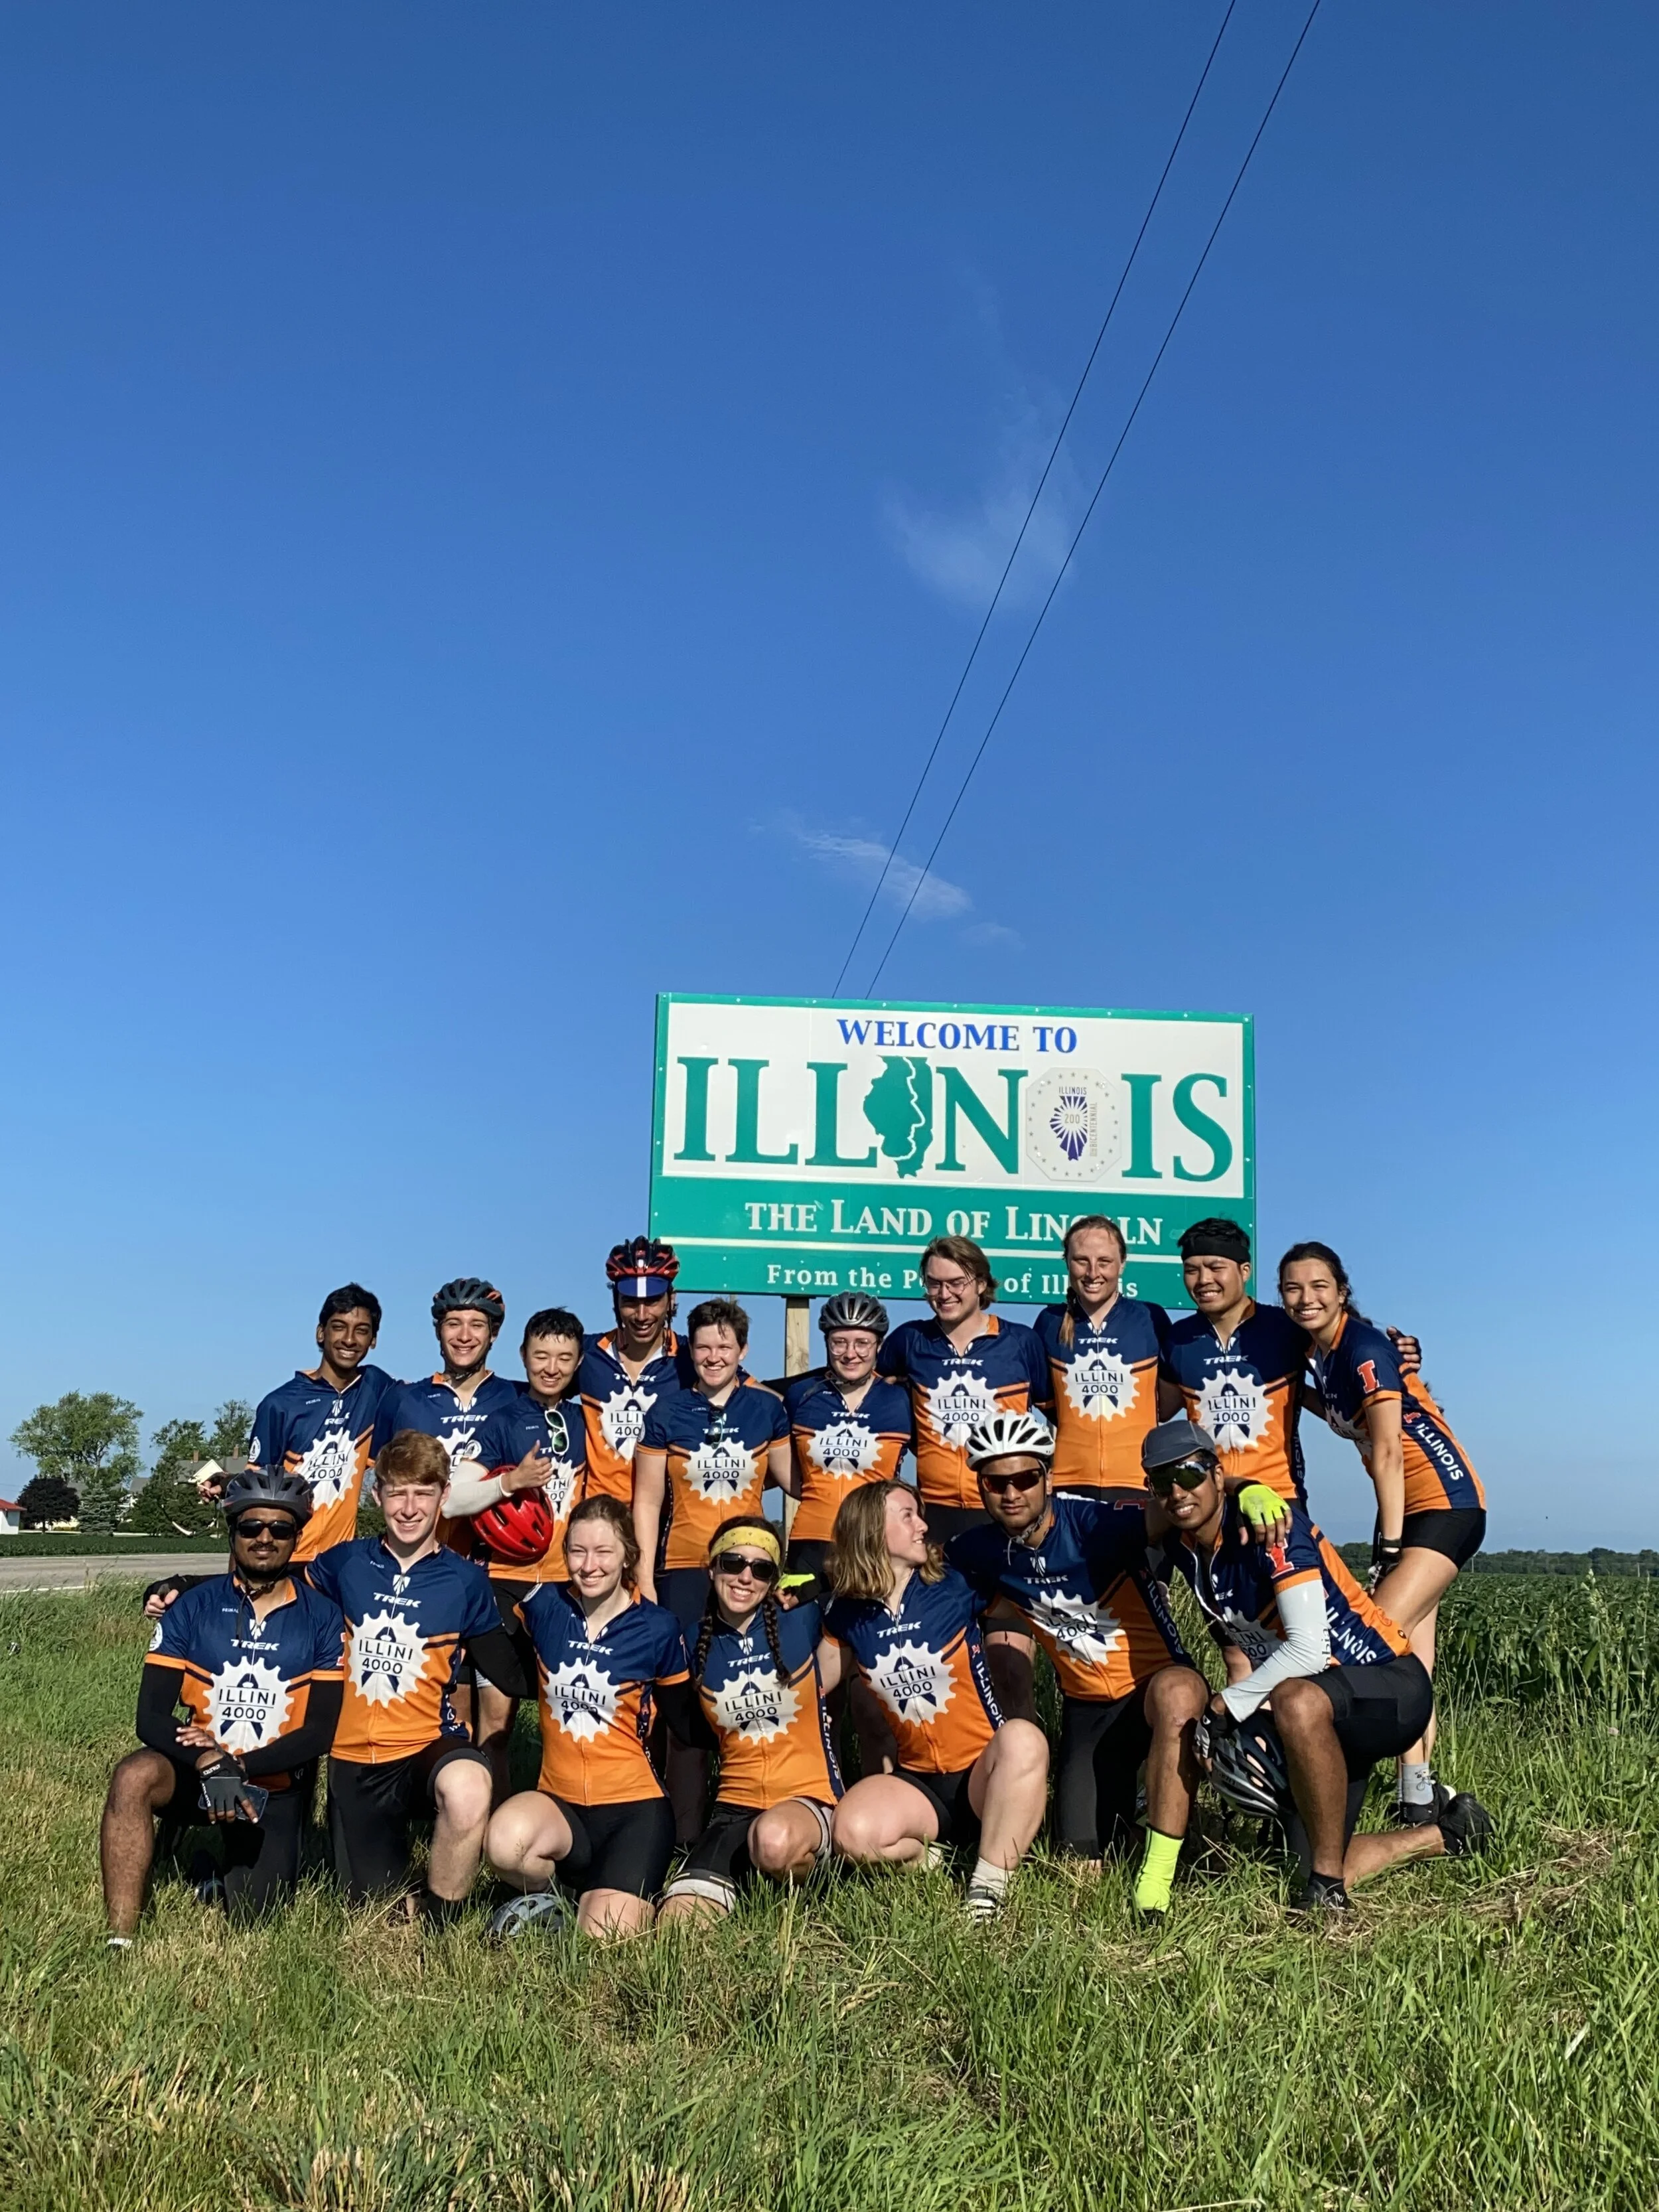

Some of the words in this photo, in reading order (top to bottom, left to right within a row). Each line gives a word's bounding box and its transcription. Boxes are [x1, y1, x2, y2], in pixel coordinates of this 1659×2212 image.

[837, 1019, 1020, 1051] WELCOME
[1033, 1026, 1078, 1053] TO
[1058, 1086, 1087, 1095] ILLINOIS
[1064, 1114, 1080, 1124] 200
[745, 1202, 817, 1232] THE
[946, 1210, 991, 1238] OF
[1005, 1205, 1163, 1246] LINLN
[767, 1264, 838, 1287] From
[848, 1266, 892, 1288] the
[1003, 1272, 1032, 1293] of
[1041, 1274, 1138, 1297] Illis
[941, 1358, 984, 1366] TREK
[1203, 1355, 1249, 1365] TREK
[1074, 1372, 1123, 1383] ILLINI
[1082, 1384, 1119, 1394] 4000
[938, 1398, 986, 1410] ILLINI
[1208, 1396, 1256, 1411] ILLINI
[440, 1414, 488, 1424] TREK
[611, 1412, 645, 1423] ILLI
[942, 1412, 979, 1422] 4000
[1213, 1412, 1250, 1422] 4000
[615, 1426, 641, 1437] 400
[820, 1437, 867, 1448] ILLINI
[823, 1447, 860, 1458] 4000
[1415, 1423, 1464, 1481] ILLINOIS
[308, 1453, 349, 1471] ILLINI
[697, 1459, 746, 1469] ILLINI
[702, 1470, 740, 1479] 4000
[1023, 1574, 1069, 1584] TREK
[374, 1592, 422, 1608] TREK
[877, 1621, 922, 1639] TREK
[1327, 1606, 1377, 1664] ILNOIS
[231, 1639, 280, 1651] TREK
[359, 1639, 413, 1660] ILLINI
[568, 1640, 614, 1655] TREK
[362, 1657, 403, 1674] 4000
[727, 1652, 771, 1668] TREK
[880, 1666, 936, 1688] ILLINI
[219, 1688, 276, 1706] ILLINI
[555, 1685, 606, 1706] ILLINI
[893, 1681, 932, 1698] 4000
[725, 1690, 782, 1713] ILLINI
[222, 1706, 266, 1720] 4000
[735, 1706, 778, 1722] 4000
